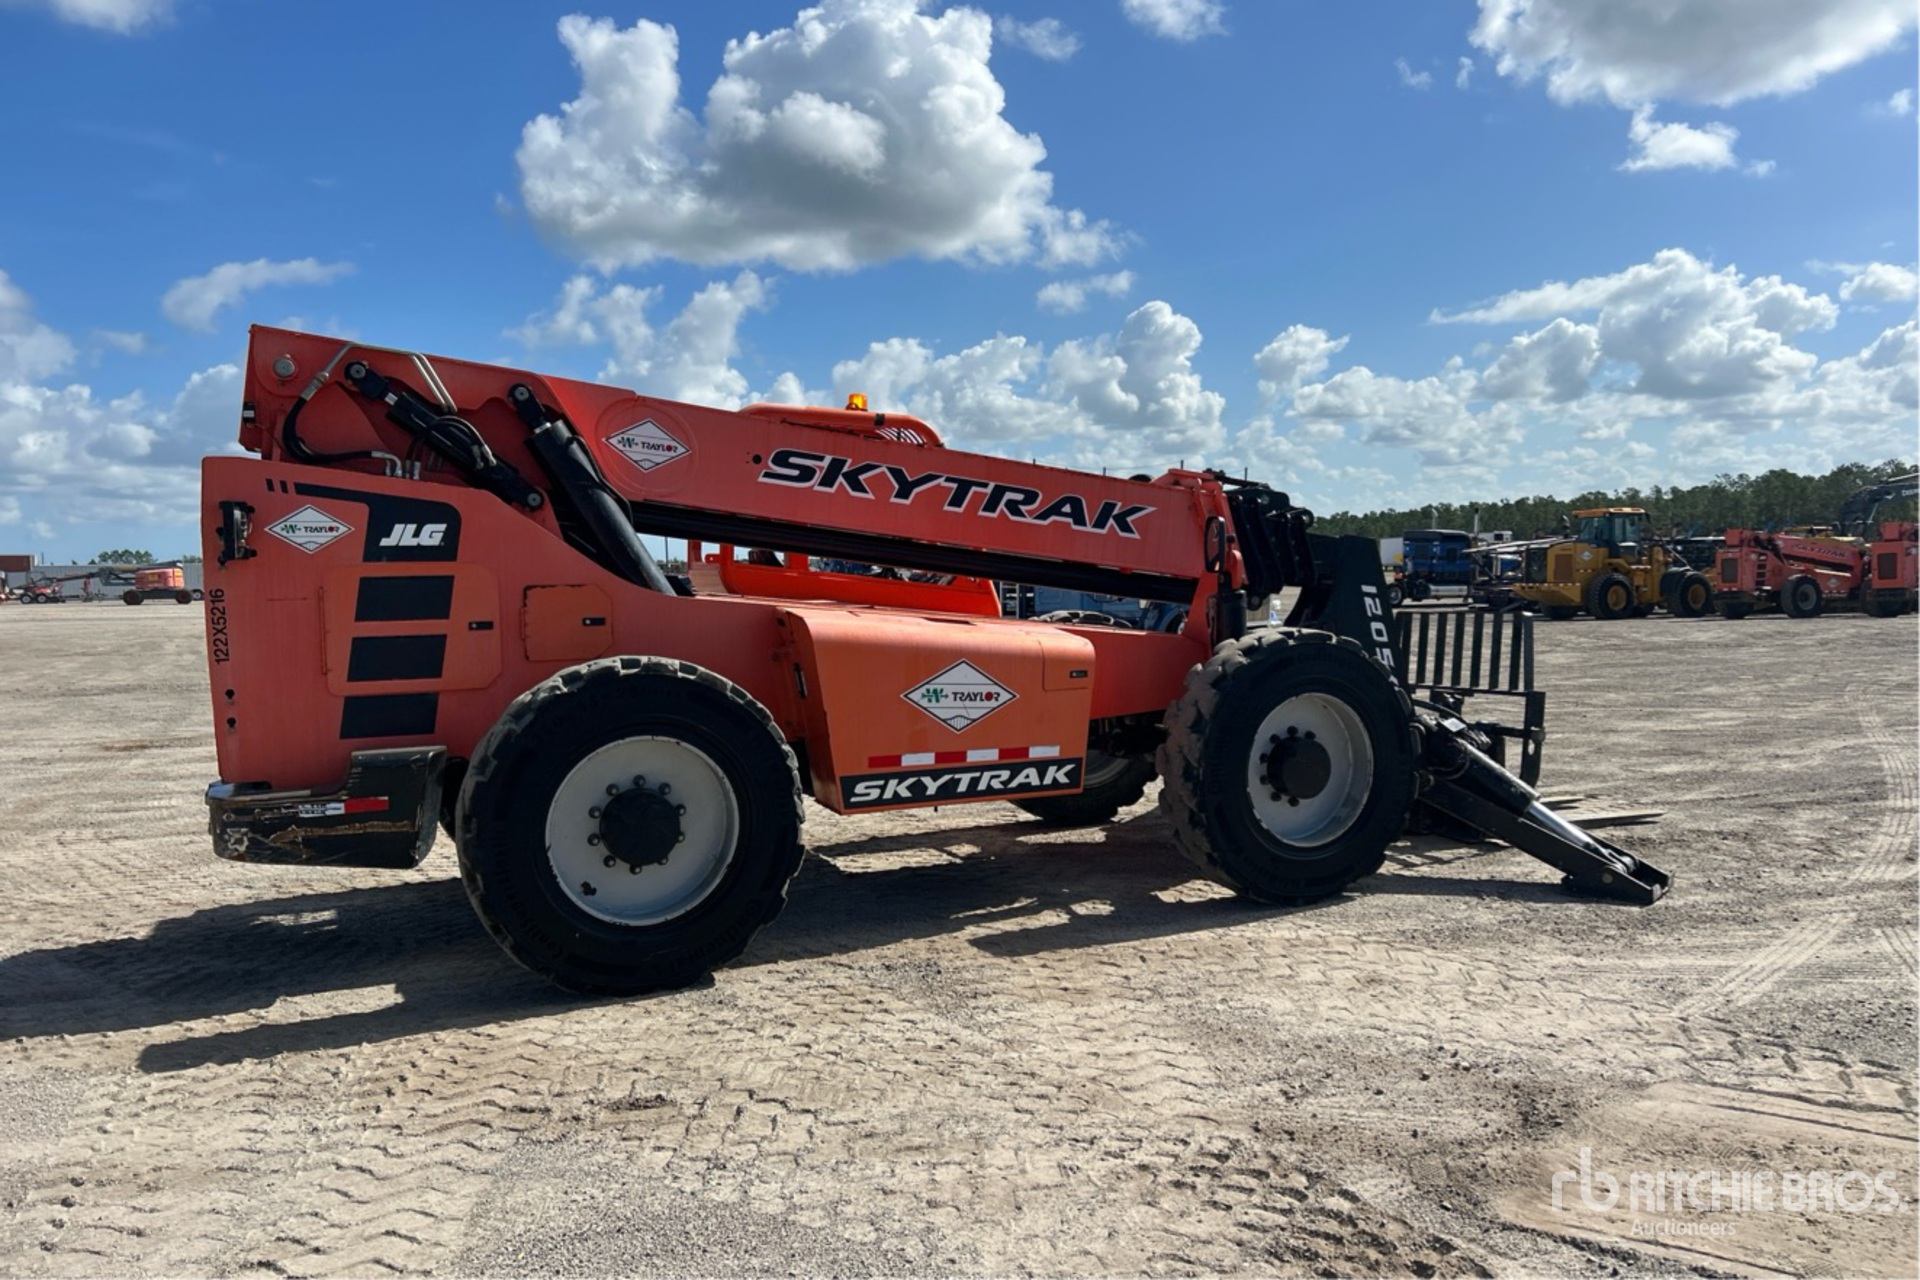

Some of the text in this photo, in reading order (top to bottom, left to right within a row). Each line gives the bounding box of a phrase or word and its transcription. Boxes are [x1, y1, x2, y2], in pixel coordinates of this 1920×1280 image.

[641, 441, 678, 453] TRAYLOR
[757, 448, 1157, 538] SKYTRAK
[379, 523, 448, 546] JLG
[209, 588, 229, 665] 122X5216
[952, 691, 1001, 702] TRAYLOR
[850, 764, 1076, 802] SKYTRAK
